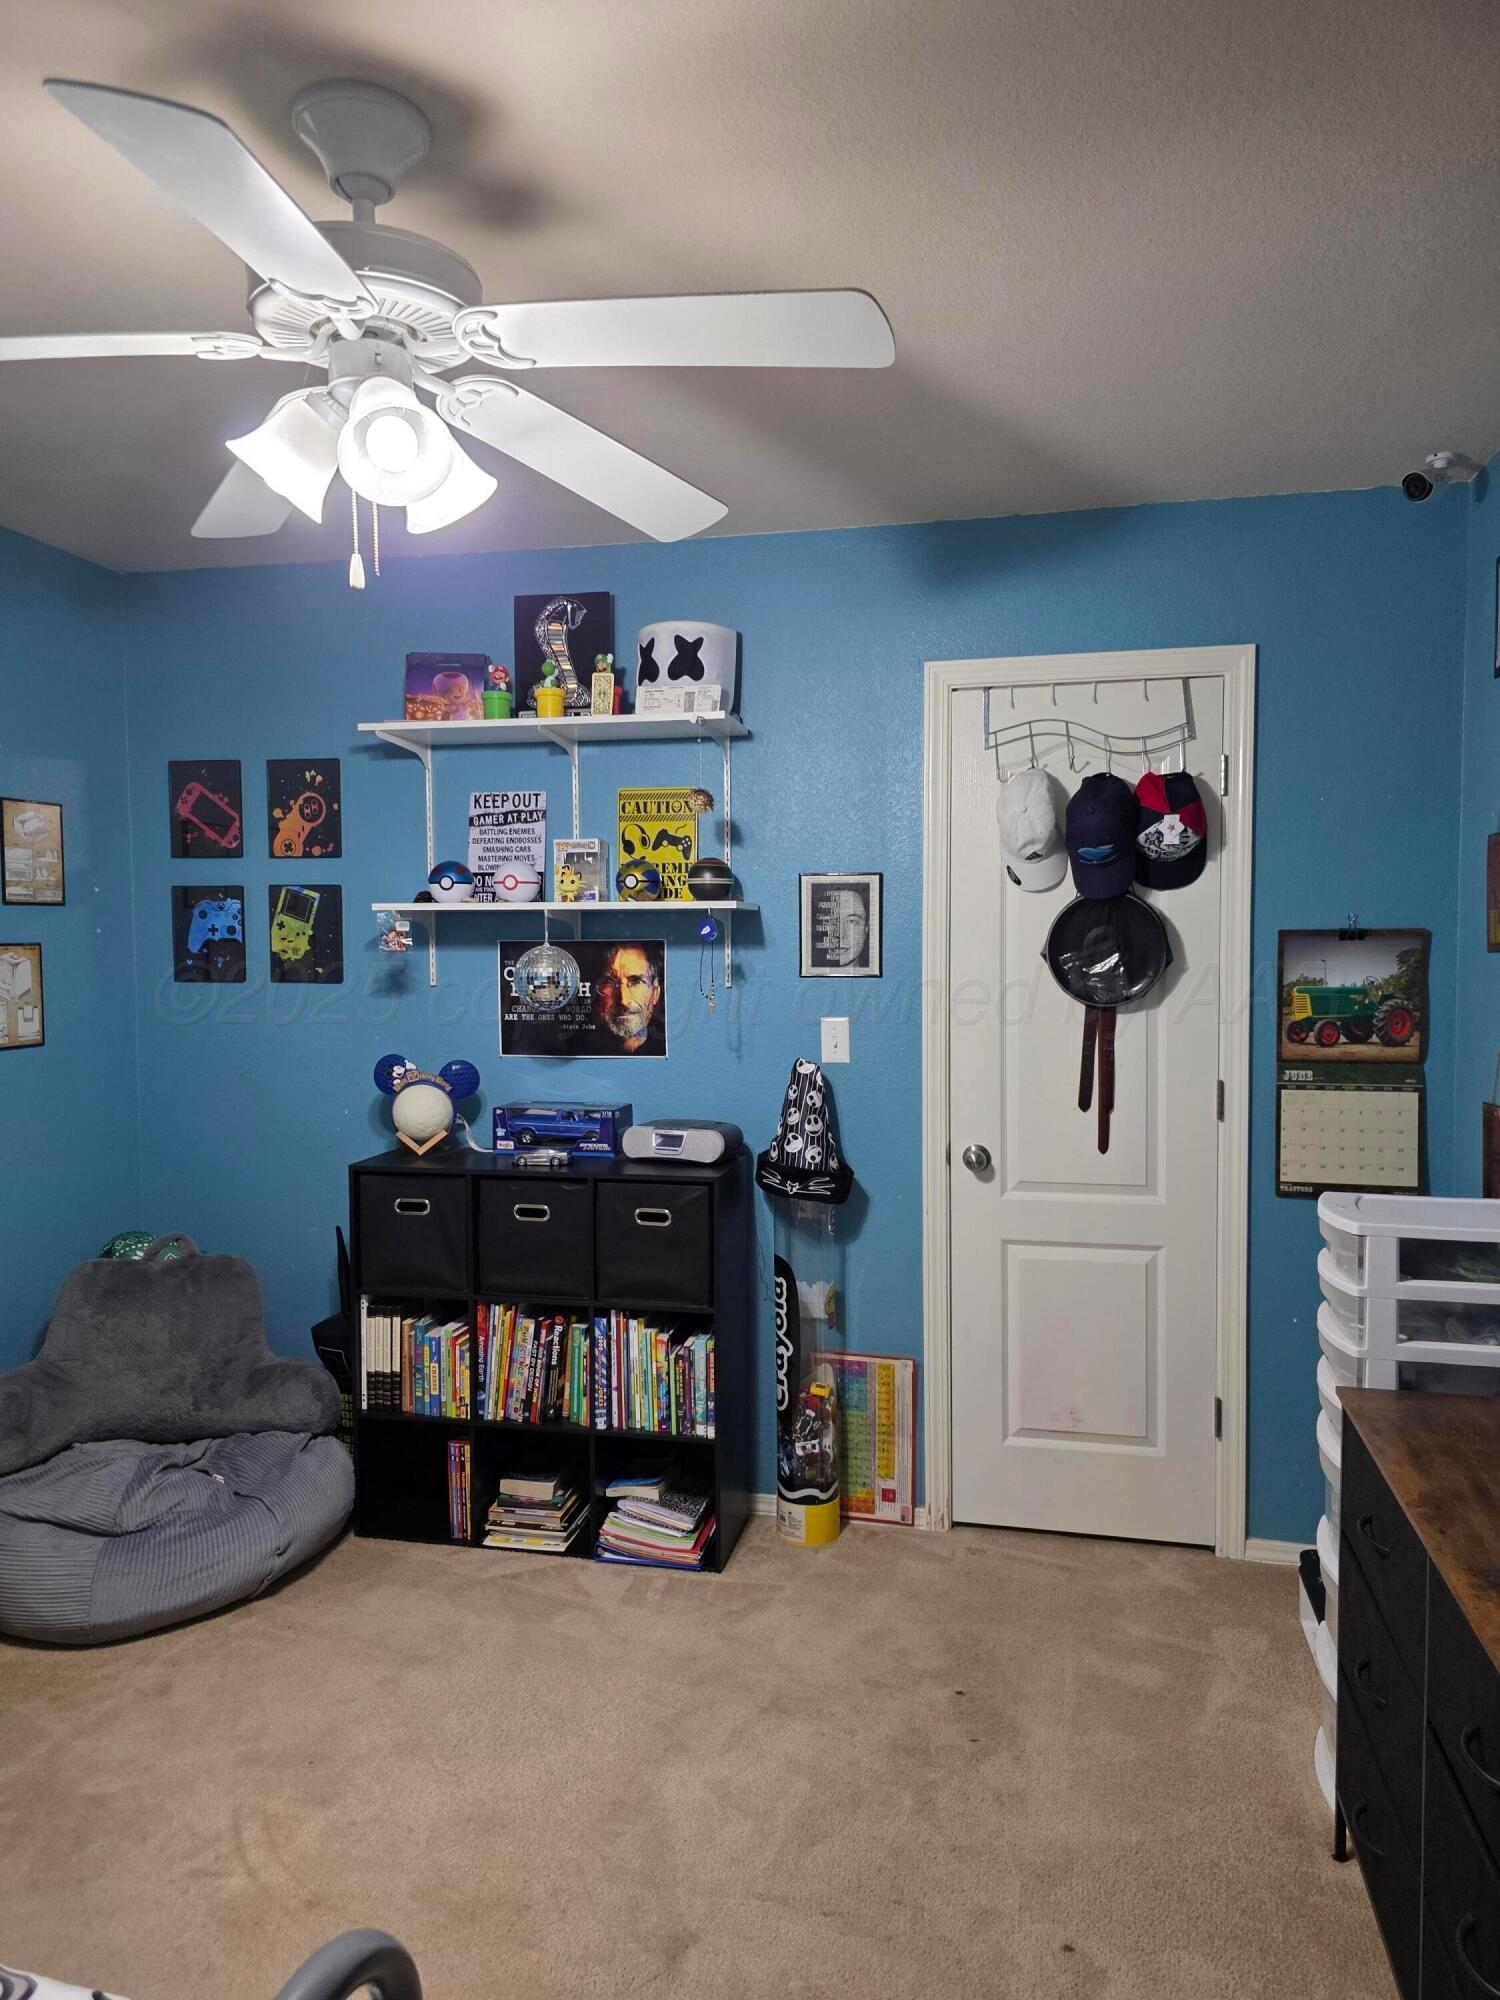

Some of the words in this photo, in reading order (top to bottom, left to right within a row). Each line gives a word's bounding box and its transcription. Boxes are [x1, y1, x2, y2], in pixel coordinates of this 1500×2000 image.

[474, 794, 509, 809] KEEP
[512, 793, 541, 809] OUT
[621, 801, 693, 815] CAUTION
[507, 813, 520, 824] AT
[521, 811, 544, 822] PLAY
[472, 837, 505, 845] DEFEATING
[504, 1013, 518, 1021] ARE
[521, 1013, 535, 1021] THE
[1282, 1070, 1313, 1081] JUNE
[478, 1335, 486, 1364] Amazing
[551, 1325, 564, 1366] Reactions
[775, 1276, 794, 1411] Crayola
[527, 1367, 535, 1392] DESIGN
